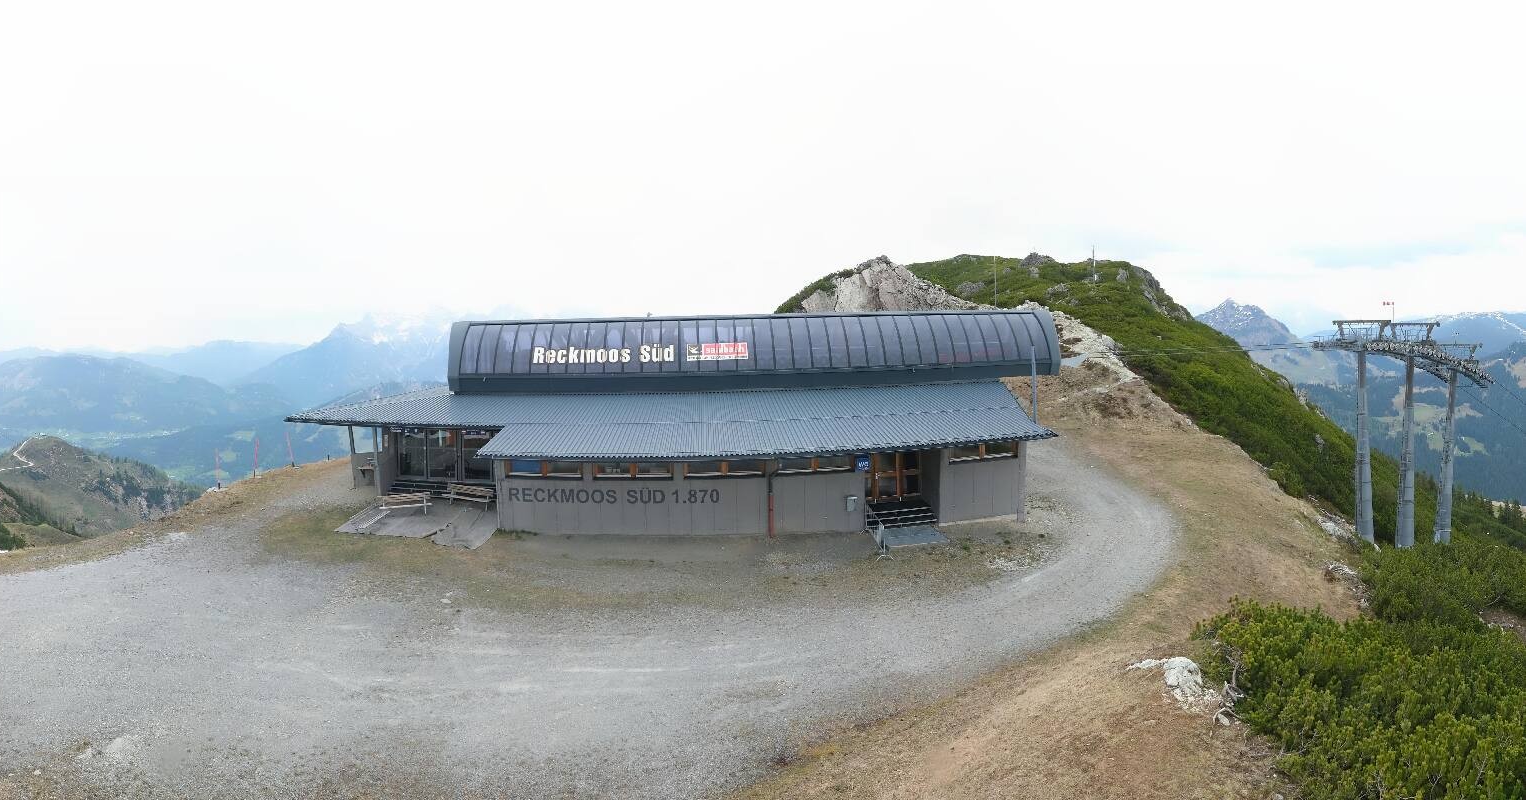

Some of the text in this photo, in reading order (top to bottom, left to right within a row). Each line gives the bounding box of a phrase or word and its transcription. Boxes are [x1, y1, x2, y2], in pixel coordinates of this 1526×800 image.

[532, 344, 675, 364] Reckmoos Süd
[508, 487, 720, 504] RECKMOOS SÜD 1.870
